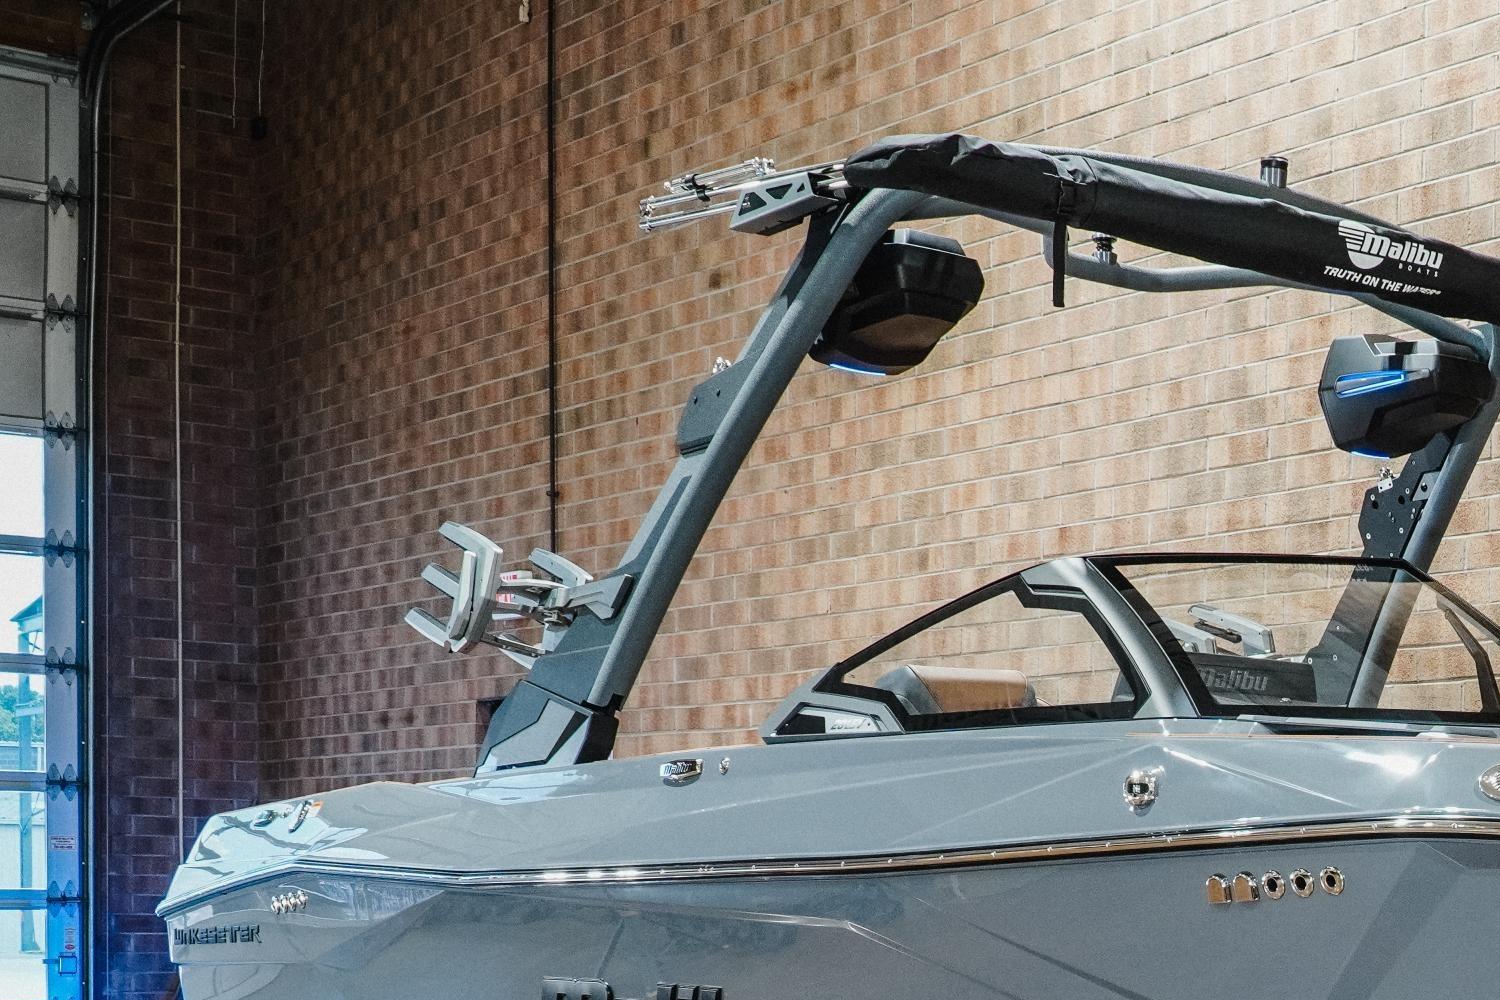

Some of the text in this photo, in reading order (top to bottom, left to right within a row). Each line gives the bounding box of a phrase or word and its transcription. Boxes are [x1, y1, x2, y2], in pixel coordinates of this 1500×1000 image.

[1361, 233, 1443, 269] Malibu
[1323, 265, 1362, 282] TRUTH
[1362, 274, 1380, 288] ON
[1380, 279, 1403, 292] THE
[1399, 262, 1438, 277] BOATS
